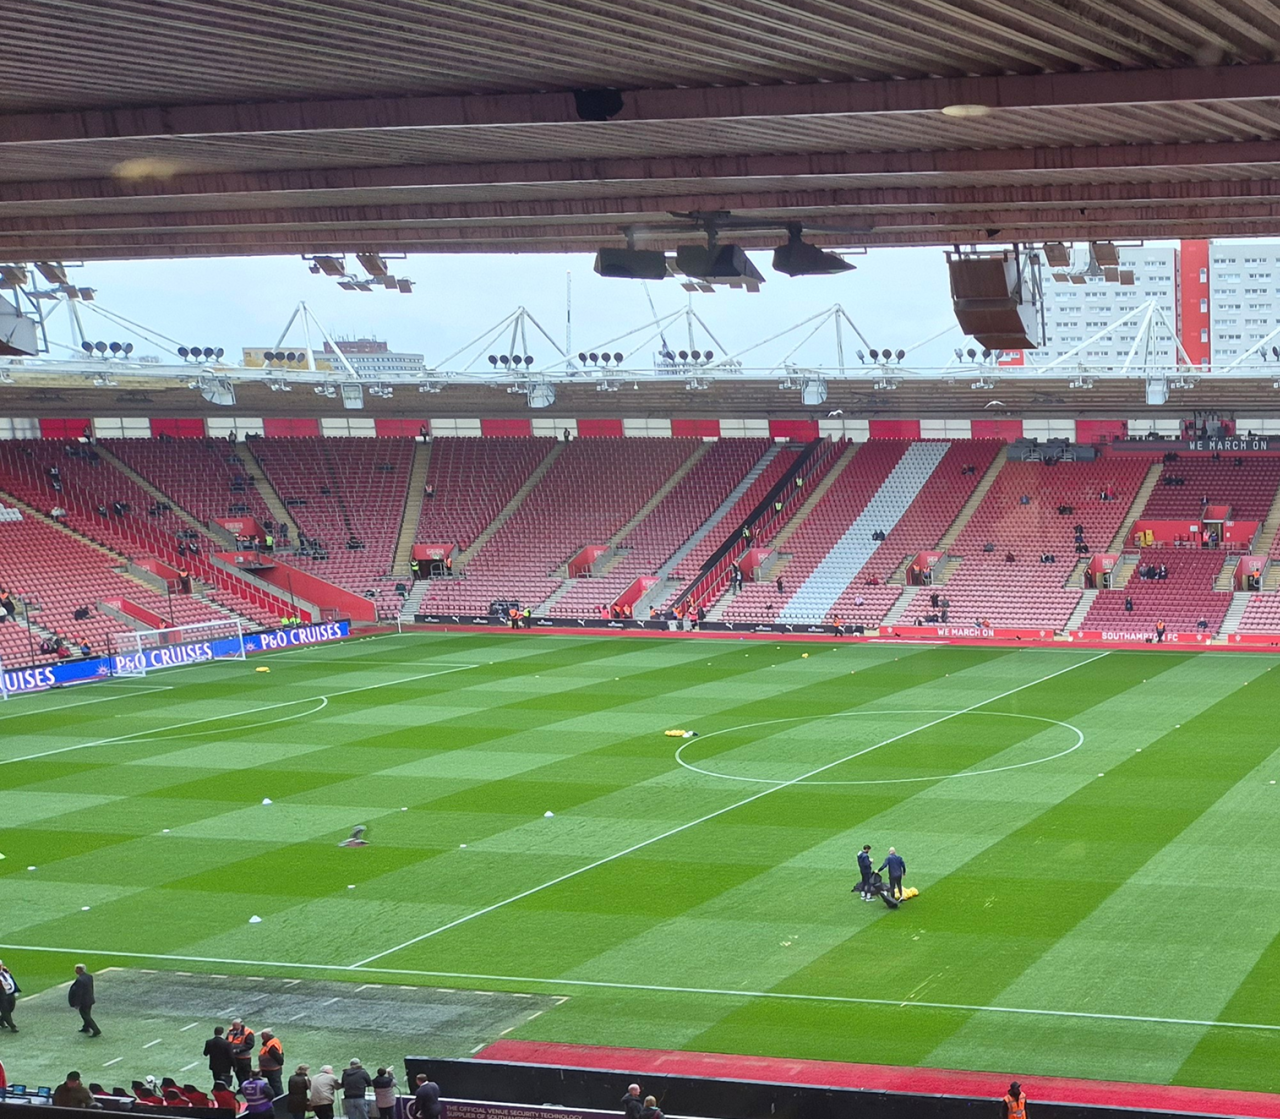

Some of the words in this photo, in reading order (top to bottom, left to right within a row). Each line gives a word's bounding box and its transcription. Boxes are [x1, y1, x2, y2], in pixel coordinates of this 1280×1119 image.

[1189, 441, 1203, 450] WE
[1209, 441, 1247, 450] MARCH
[1253, 441, 1267, 450] ON
[261, 630, 287, 650] P&O
[290, 623, 342, 646] CRUISES
[937, 628, 949, 636] WE
[951, 628, 980, 636] MARCH
[982, 628, 994, 637] ON
[1167, 633, 1178, 641] FC
[115, 654, 146, 673] P&O
[152, 643, 213, 668] CRUISES
[0, 667, 55, 691] UISES
[446, 1111, 475, 1119] SUPPLIER
[459, 1106, 486, 1114] OFFICIAL
[487, 1108, 508, 1116] VENUE
